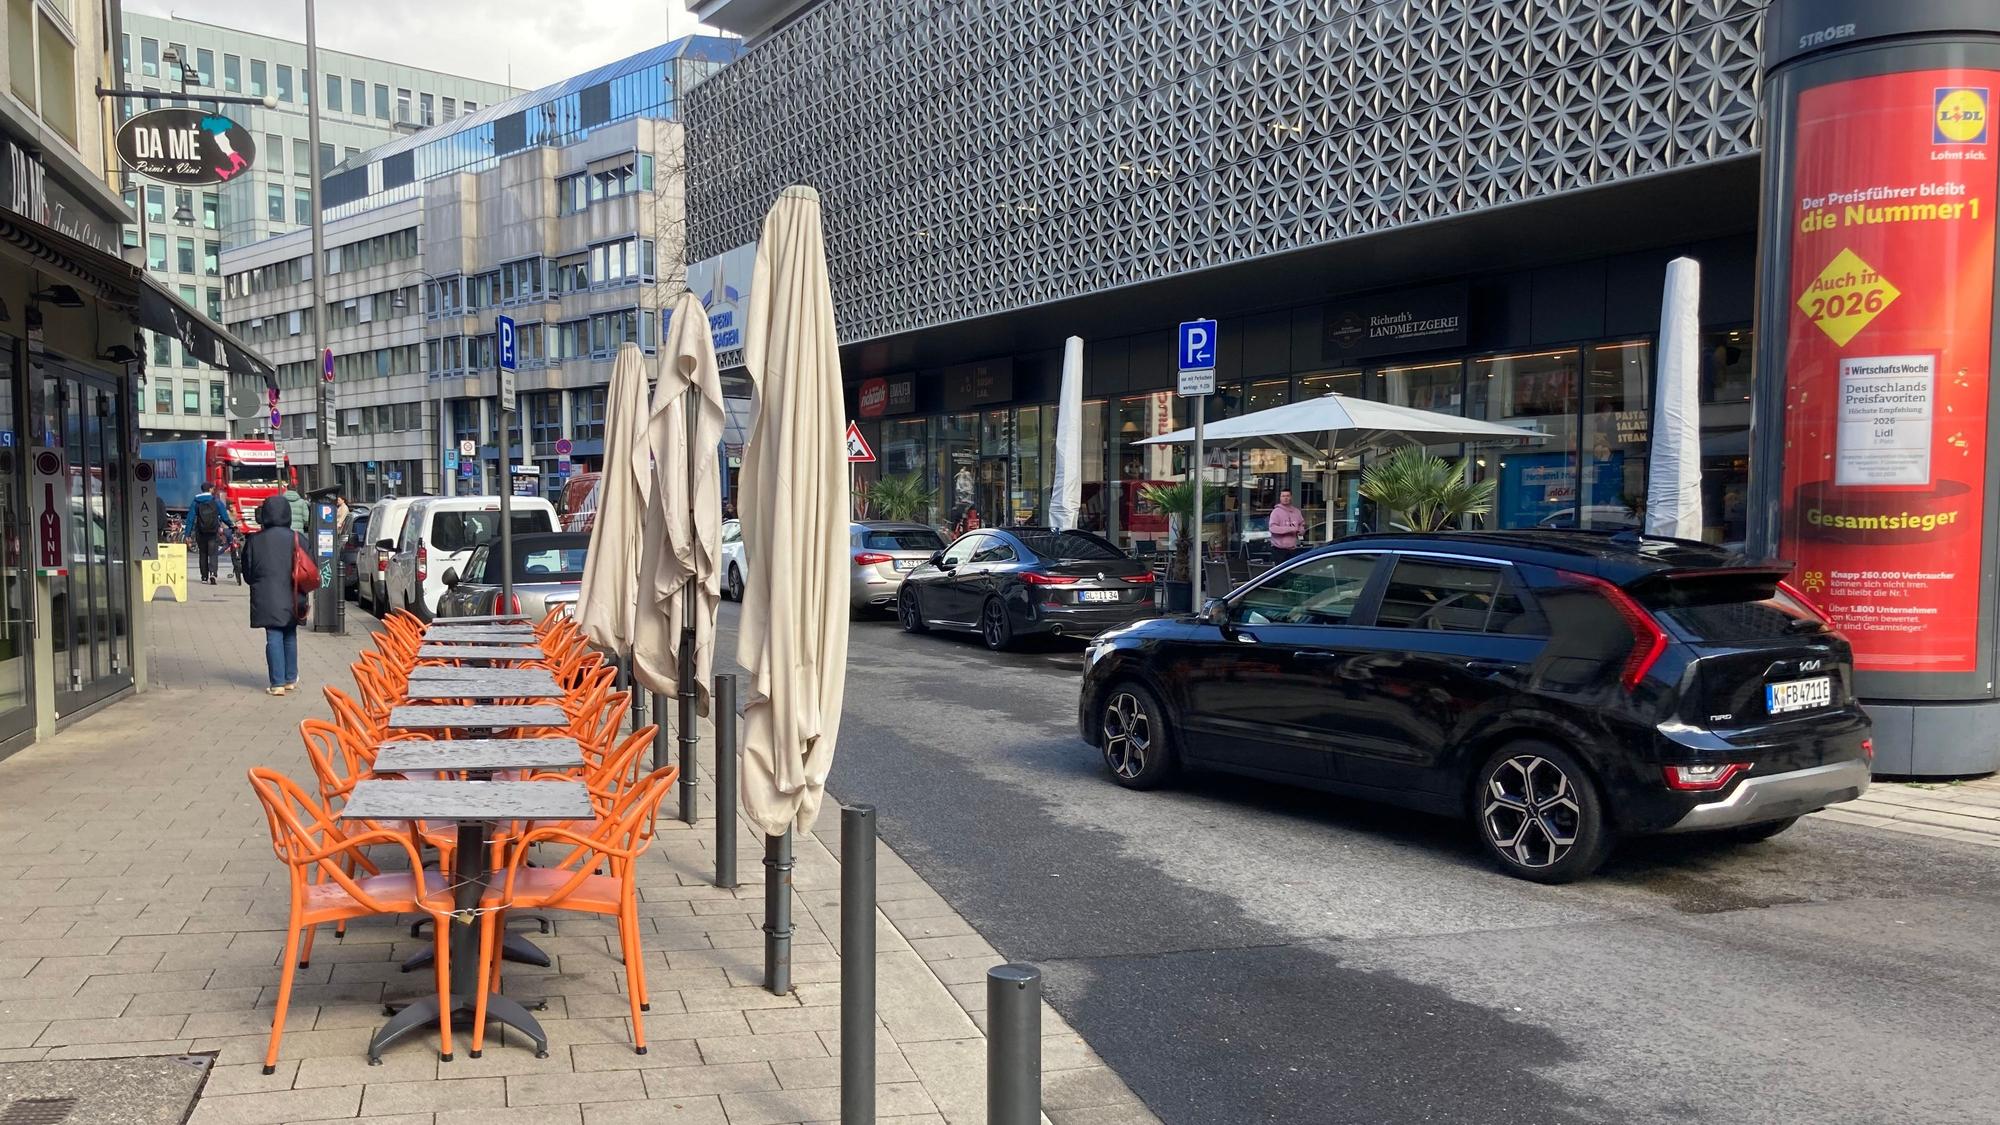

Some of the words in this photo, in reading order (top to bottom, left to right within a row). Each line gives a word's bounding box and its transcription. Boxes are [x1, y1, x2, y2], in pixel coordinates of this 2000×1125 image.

[1799, 23, 1856, 48] STRÖER
[135, 127, 164, 159] DA
[168, 123, 201, 160] MÉ
[1931, 151, 1963, 161] Lohnt
[1964, 150, 1987, 160] sich.
[136, 160, 166, 174] Primi
[176, 162, 201, 174] Vini
[1803, 197, 1825, 210] Der
[1828, 186, 1917, 206] Preisführer
[1920, 182, 1965, 197] bleibt
[1800, 208, 1837, 233] die
[1844, 202, 1964, 227] Nummer
[1969, 198, 1980, 219] 1
[1811, 272, 1856, 293] Auch
[1861, 270, 1880, 285] in
[1810, 289, 1884, 322] 2026
[1369, 316, 1459, 338] LANDMETZGEREI
[1370, 312, 1413, 327] Richrath's
[502, 322, 512, 362] P
[1187, 327, 1207, 363] P
[1846, 382, 1927, 394] Deutschlands
[1846, 393, 1926, 405] Preisfavoriten
[1879, 406, 1923, 415] Empfehlung
[1873, 417, 1896, 425] 2026
[1875, 429, 1894, 438] Lidl
[140, 486, 152, 557] PASTA
[1807, 509, 1958, 531] Gesamtsieger
[46, 514, 55, 566] VINI
[1831, 571, 1860, 580] Knapp
[1902, 571, 1955, 580] Verbraucher
[1883, 580, 1905, 588] nicht
[1830, 588, 1846, 596] Lidl
[1847, 588, 1872, 596] bleibt
[1873, 589, 1887, 597] die
[1889, 589, 1901, 597] Nr.
[1829, 604, 1849, 612] Über
[1876, 605, 1938, 614] Unternehmen
[1845, 614, 1879, 622] Kunden
[1880, 614, 1920, 623] bewertet.
[1843, 622, 1862, 631] sind
[1774, 688, 1780, 706] K
